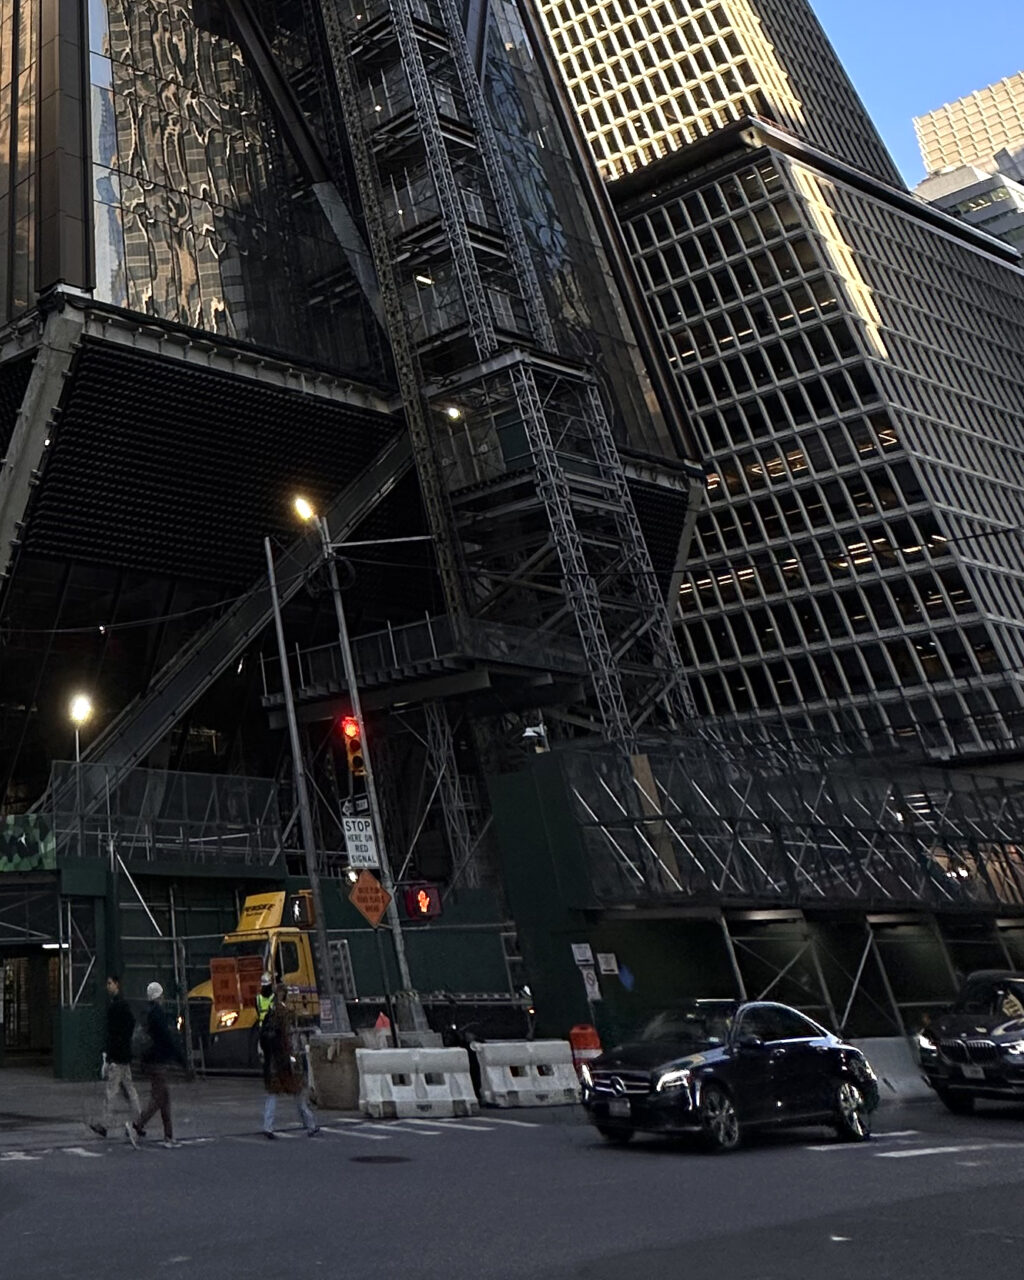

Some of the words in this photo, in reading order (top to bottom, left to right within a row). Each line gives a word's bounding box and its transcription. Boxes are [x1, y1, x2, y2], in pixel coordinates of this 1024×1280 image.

[345, 820, 370, 832] STOP
[347, 833, 363, 842] HERE
[355, 844, 369, 853] RED
[351, 854, 377, 864] SIGNAL
